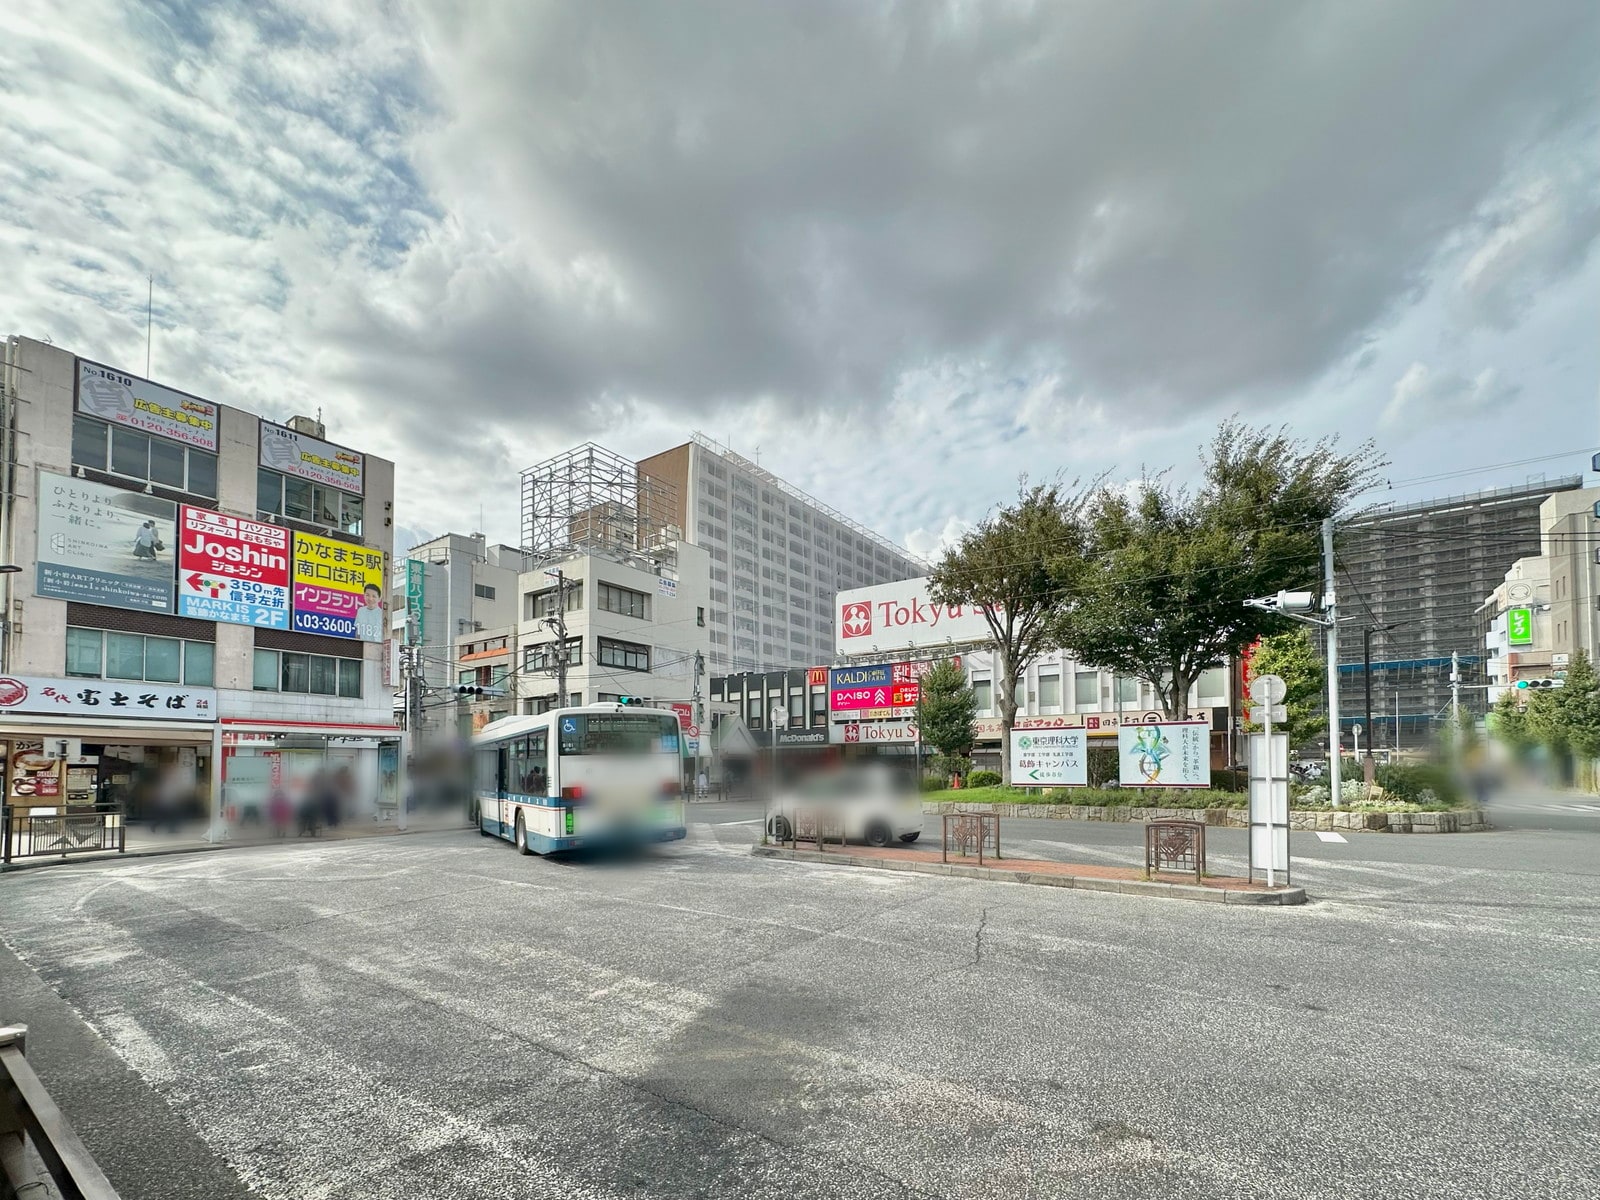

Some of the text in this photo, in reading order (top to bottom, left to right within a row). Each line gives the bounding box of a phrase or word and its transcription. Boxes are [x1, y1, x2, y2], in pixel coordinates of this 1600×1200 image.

[134, 398, 213, 431] 広告主募集中
[131, 417, 213, 448] 0120-356-508
[300, 451, 360, 477] 広告主募集中
[298, 468, 360, 491] 0120-356-508
[191, 521, 281, 547] リフォーム おもちゃ
[244, 523, 281, 537] パソコン
[67, 537, 108, 549] SHINKOIWA
[184, 534, 286, 570] Joshin
[67, 549, 94, 558] CLINIC
[296, 538, 381, 571] かなまち駅
[211, 560, 263, 578] ジョーシン
[296, 559, 366, 588] 南口歯科
[101, 585, 168, 601] shinkoiwa-ac.com
[230, 579, 285, 597] 350m先
[186, 597, 250, 614] MARK IS
[230, 590, 285, 608] 信号左折
[296, 586, 364, 610] インプラント
[187, 606, 250, 623] 葛飾かなまち
[255, 608, 284, 626] 2F
[1513, 612, 1525, 635] レイク
[303, 614, 378, 638] 03-3600-1182
[836, 671, 867, 685] KALDI
[77, 688, 189, 709] 富士そば
[836, 691, 871, 701] DAISO
[779, 733, 825, 742] McDonald's
[863, 725, 902, 742] Tokyu
[1033, 736, 1078, 745] 東京理科大学
[1020, 760, 1079, 768] 葛飾キャンパス
